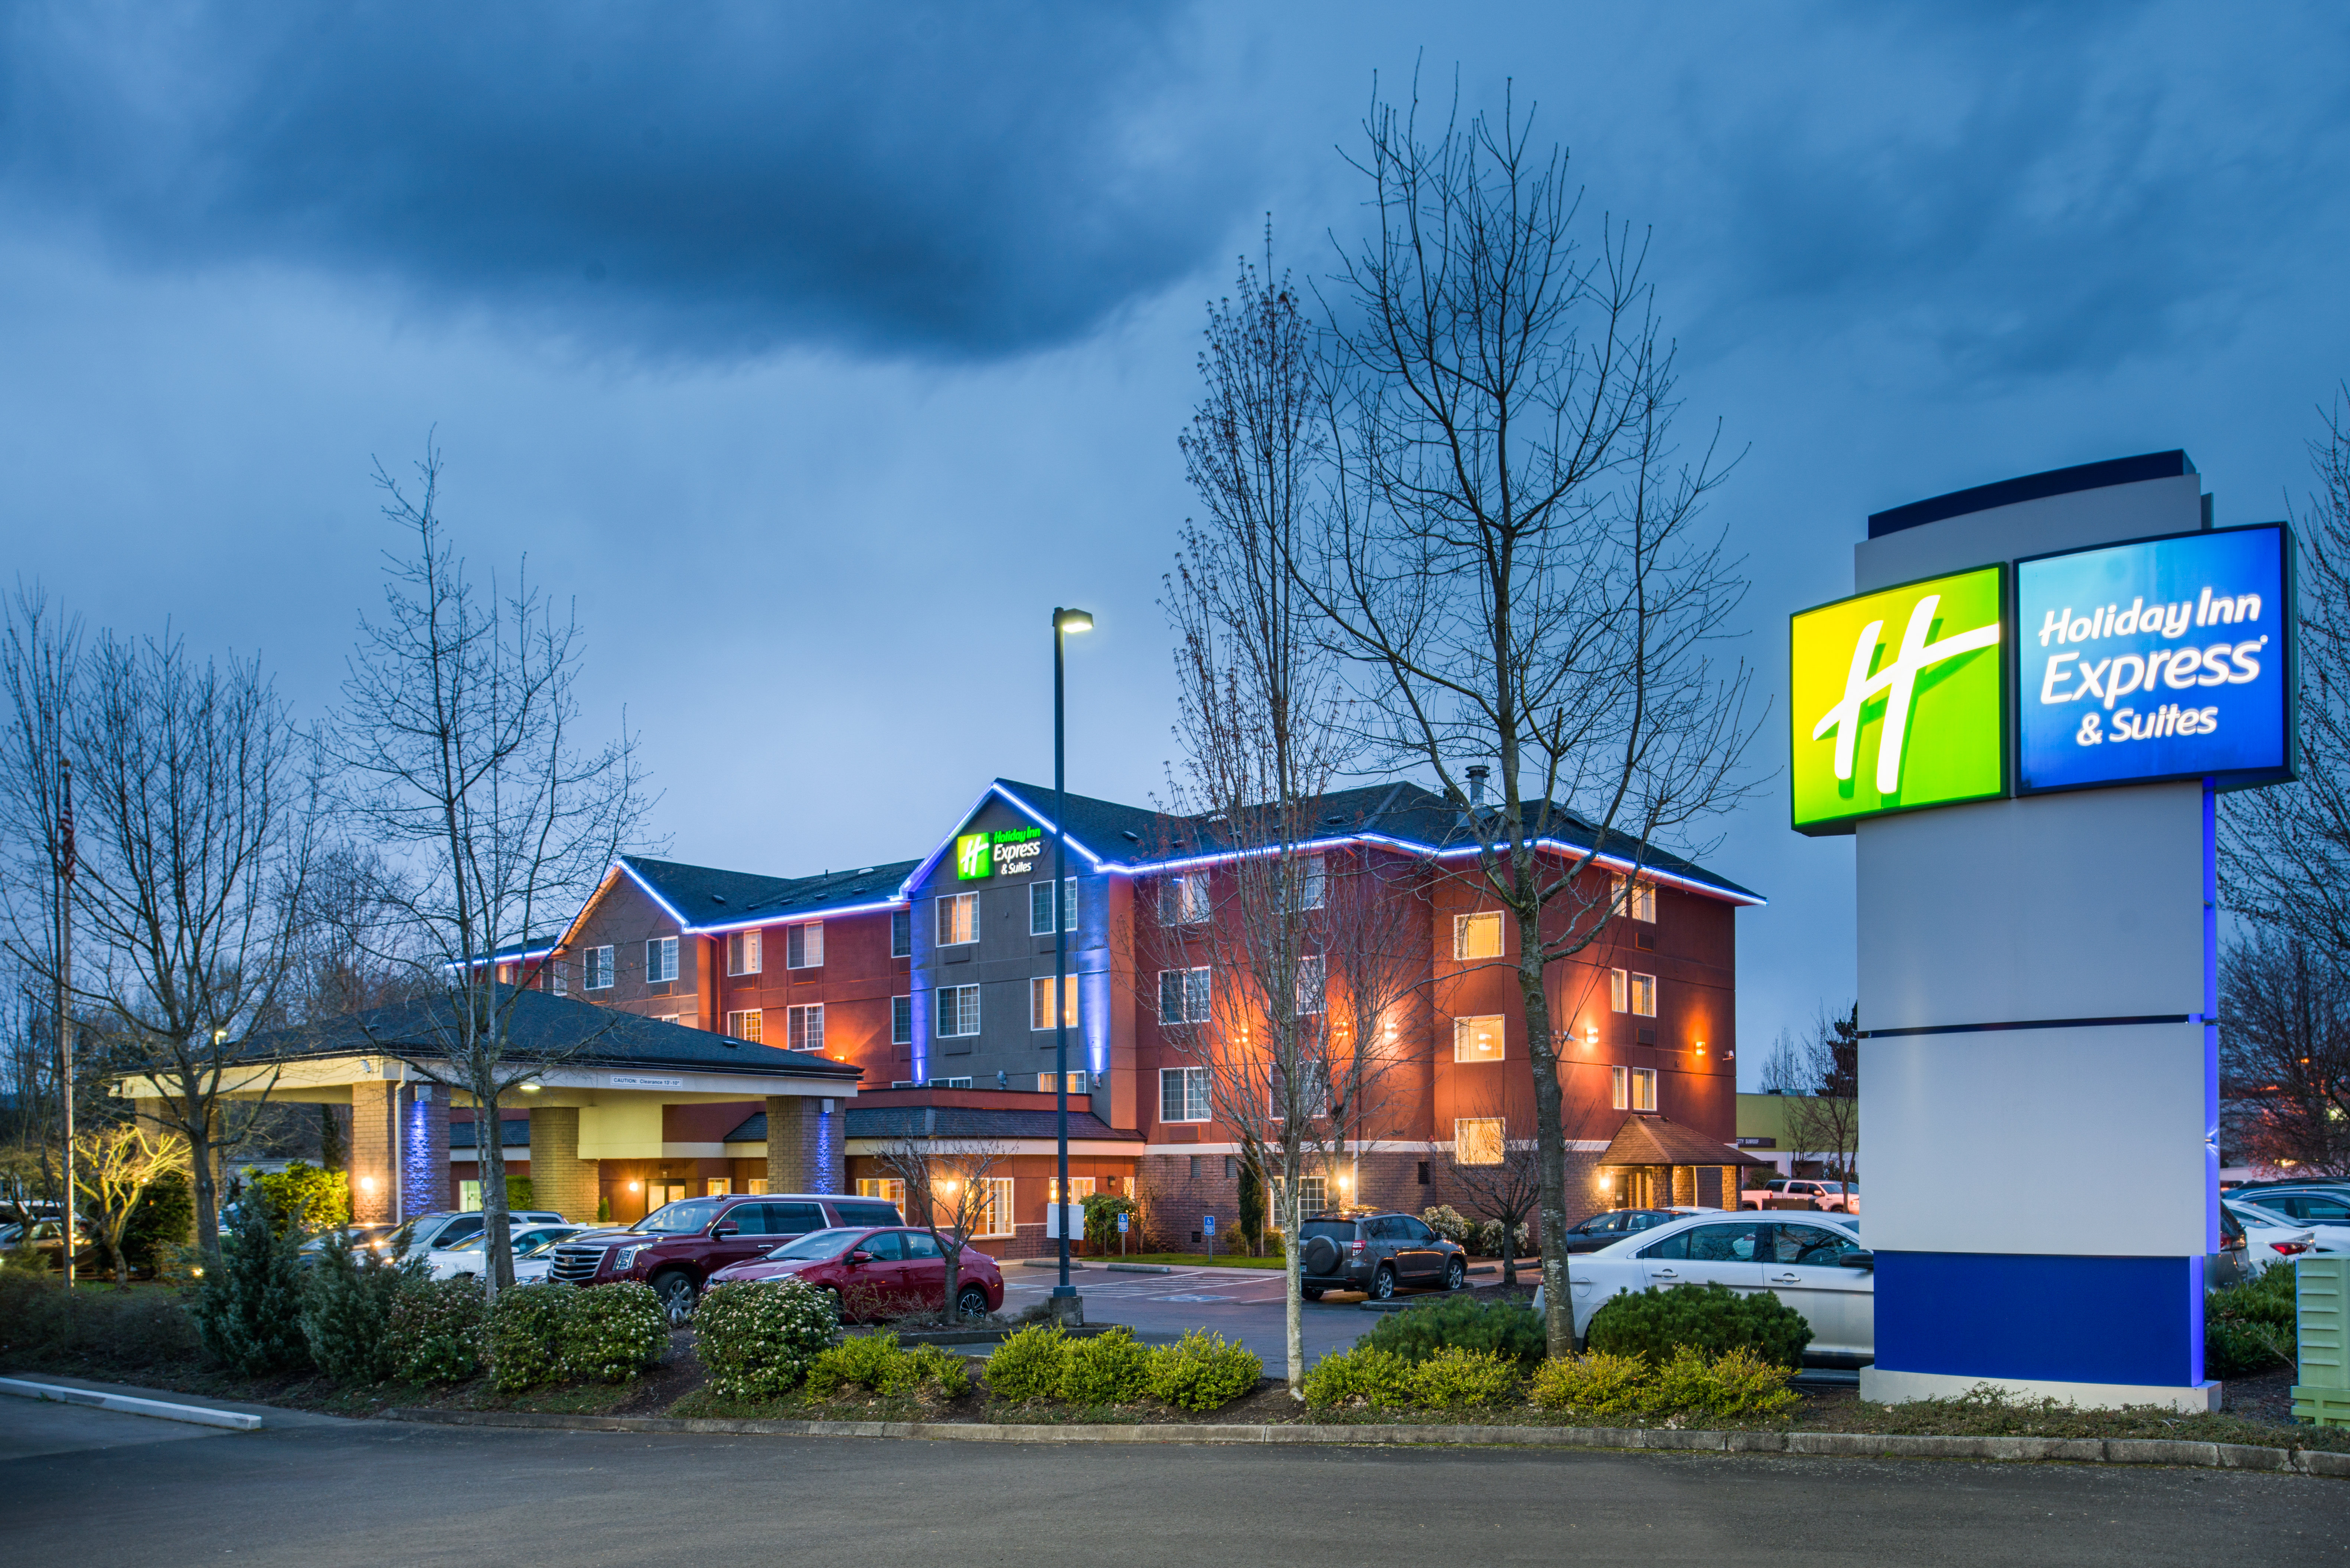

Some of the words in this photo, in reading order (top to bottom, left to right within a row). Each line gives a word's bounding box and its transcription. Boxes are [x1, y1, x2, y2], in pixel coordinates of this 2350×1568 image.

[2039, 596, 2192, 647] Holiday
[2196, 587, 2261, 627] Inn
[2040, 643, 2262, 710] Express
[2076, 712, 2103, 747] &
[2109, 703, 2219, 742] Suites
[993, 829, 1027, 843] Holiday
[1027, 826, 1041, 839] Inn
[994, 841, 1041, 863] Express
[1001, 863, 1008, 875] &
[1008, 862, 1032, 875] Suites
